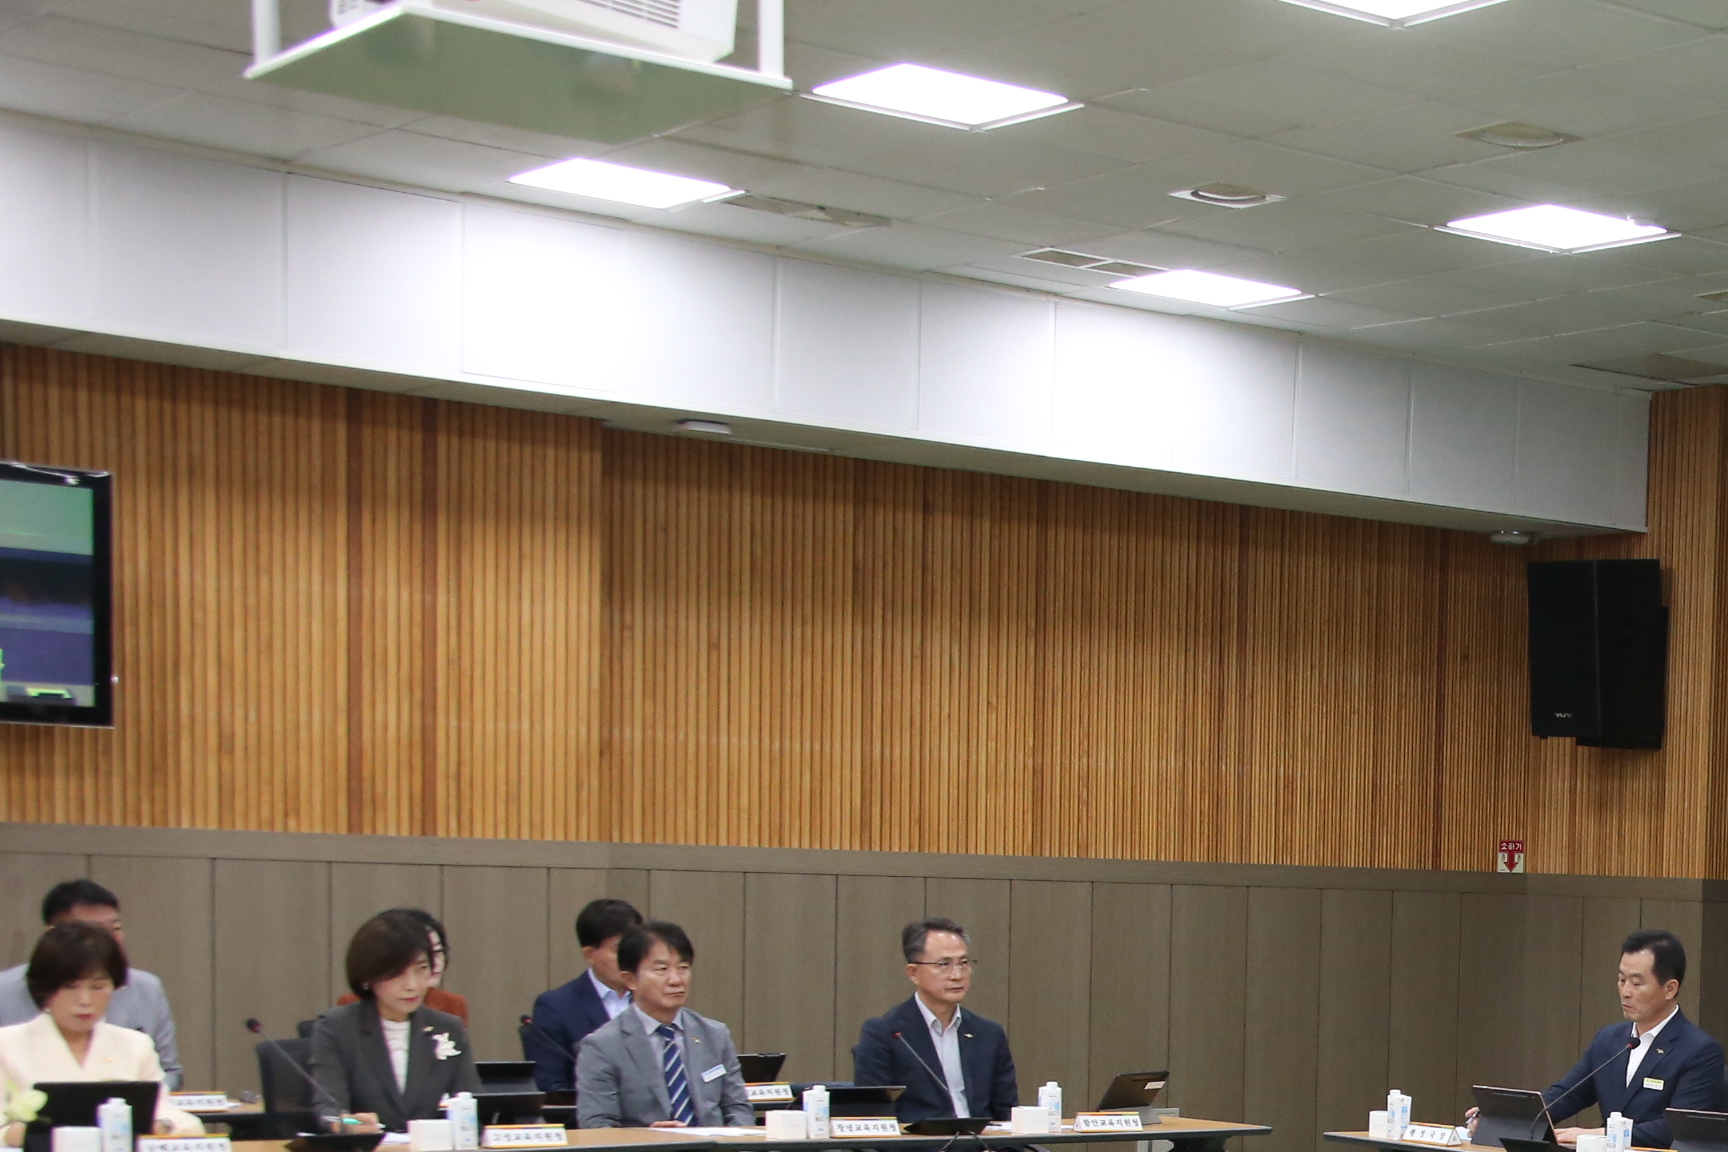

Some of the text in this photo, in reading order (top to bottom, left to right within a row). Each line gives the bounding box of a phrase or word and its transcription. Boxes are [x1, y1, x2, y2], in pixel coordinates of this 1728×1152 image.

[1500, 842, 1522, 850] 소화기
[745, 1086, 789, 1097] 교육지원청
[1083, 1118, 1139, 1128] 함안교육지원청
